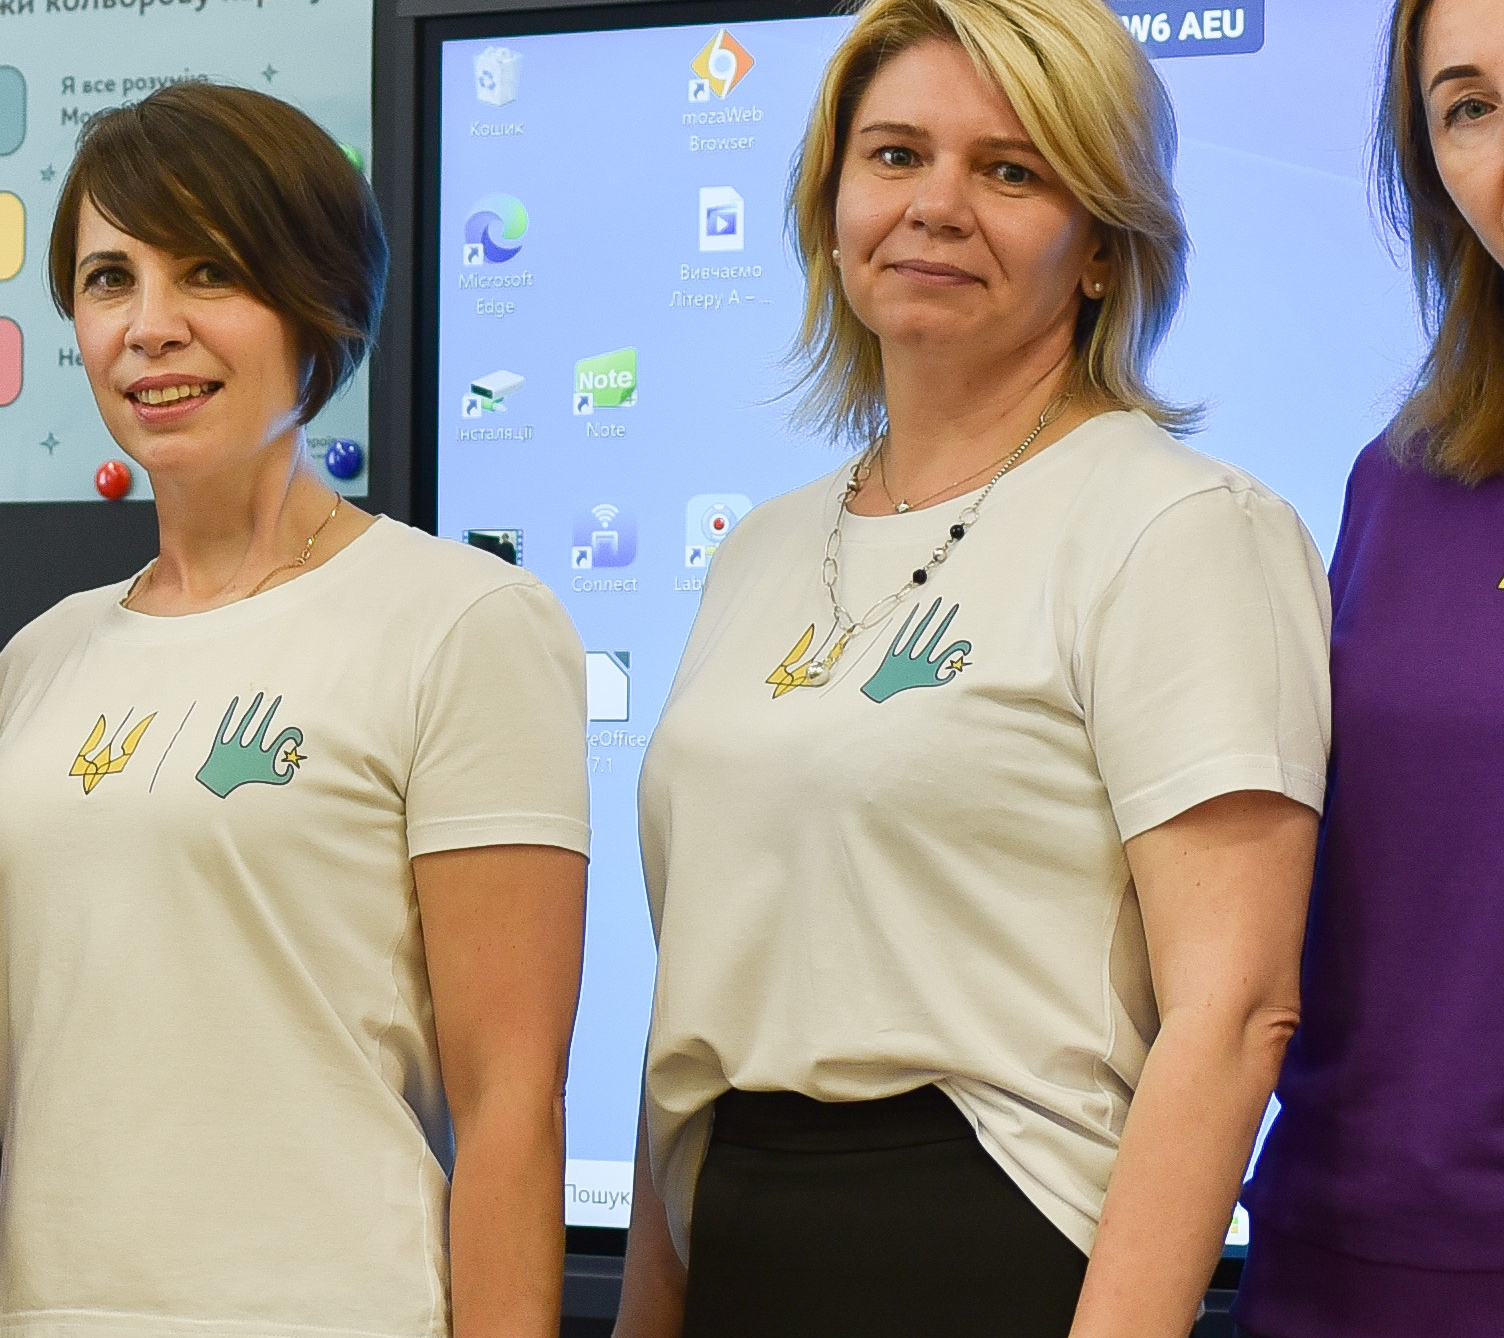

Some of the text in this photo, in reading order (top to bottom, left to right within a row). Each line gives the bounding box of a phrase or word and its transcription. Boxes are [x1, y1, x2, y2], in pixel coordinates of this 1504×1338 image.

[1177, 7, 1245, 42] AEU
[61, 75, 76, 95] Я
[83, 78, 116, 94] все
[681, 107, 764, 126] mozaWeb
[470, 120, 525, 138] Кошик
[689, 135, 756, 152] Browser
[458, 272, 534, 291] Microsoft
[679, 263, 763, 282] Вивчаємо
[476, 299, 516, 317] Edge
[668, 290, 723, 310] Літеру
[578, 366, 634, 391] Note
[585, 422, 626, 439] Note
[571, 575, 639, 593] Connect
[675, 575, 702, 592] Lab
[587, 729, 648, 748] eOffice
[565, 1183, 632, 1211] Пошук
